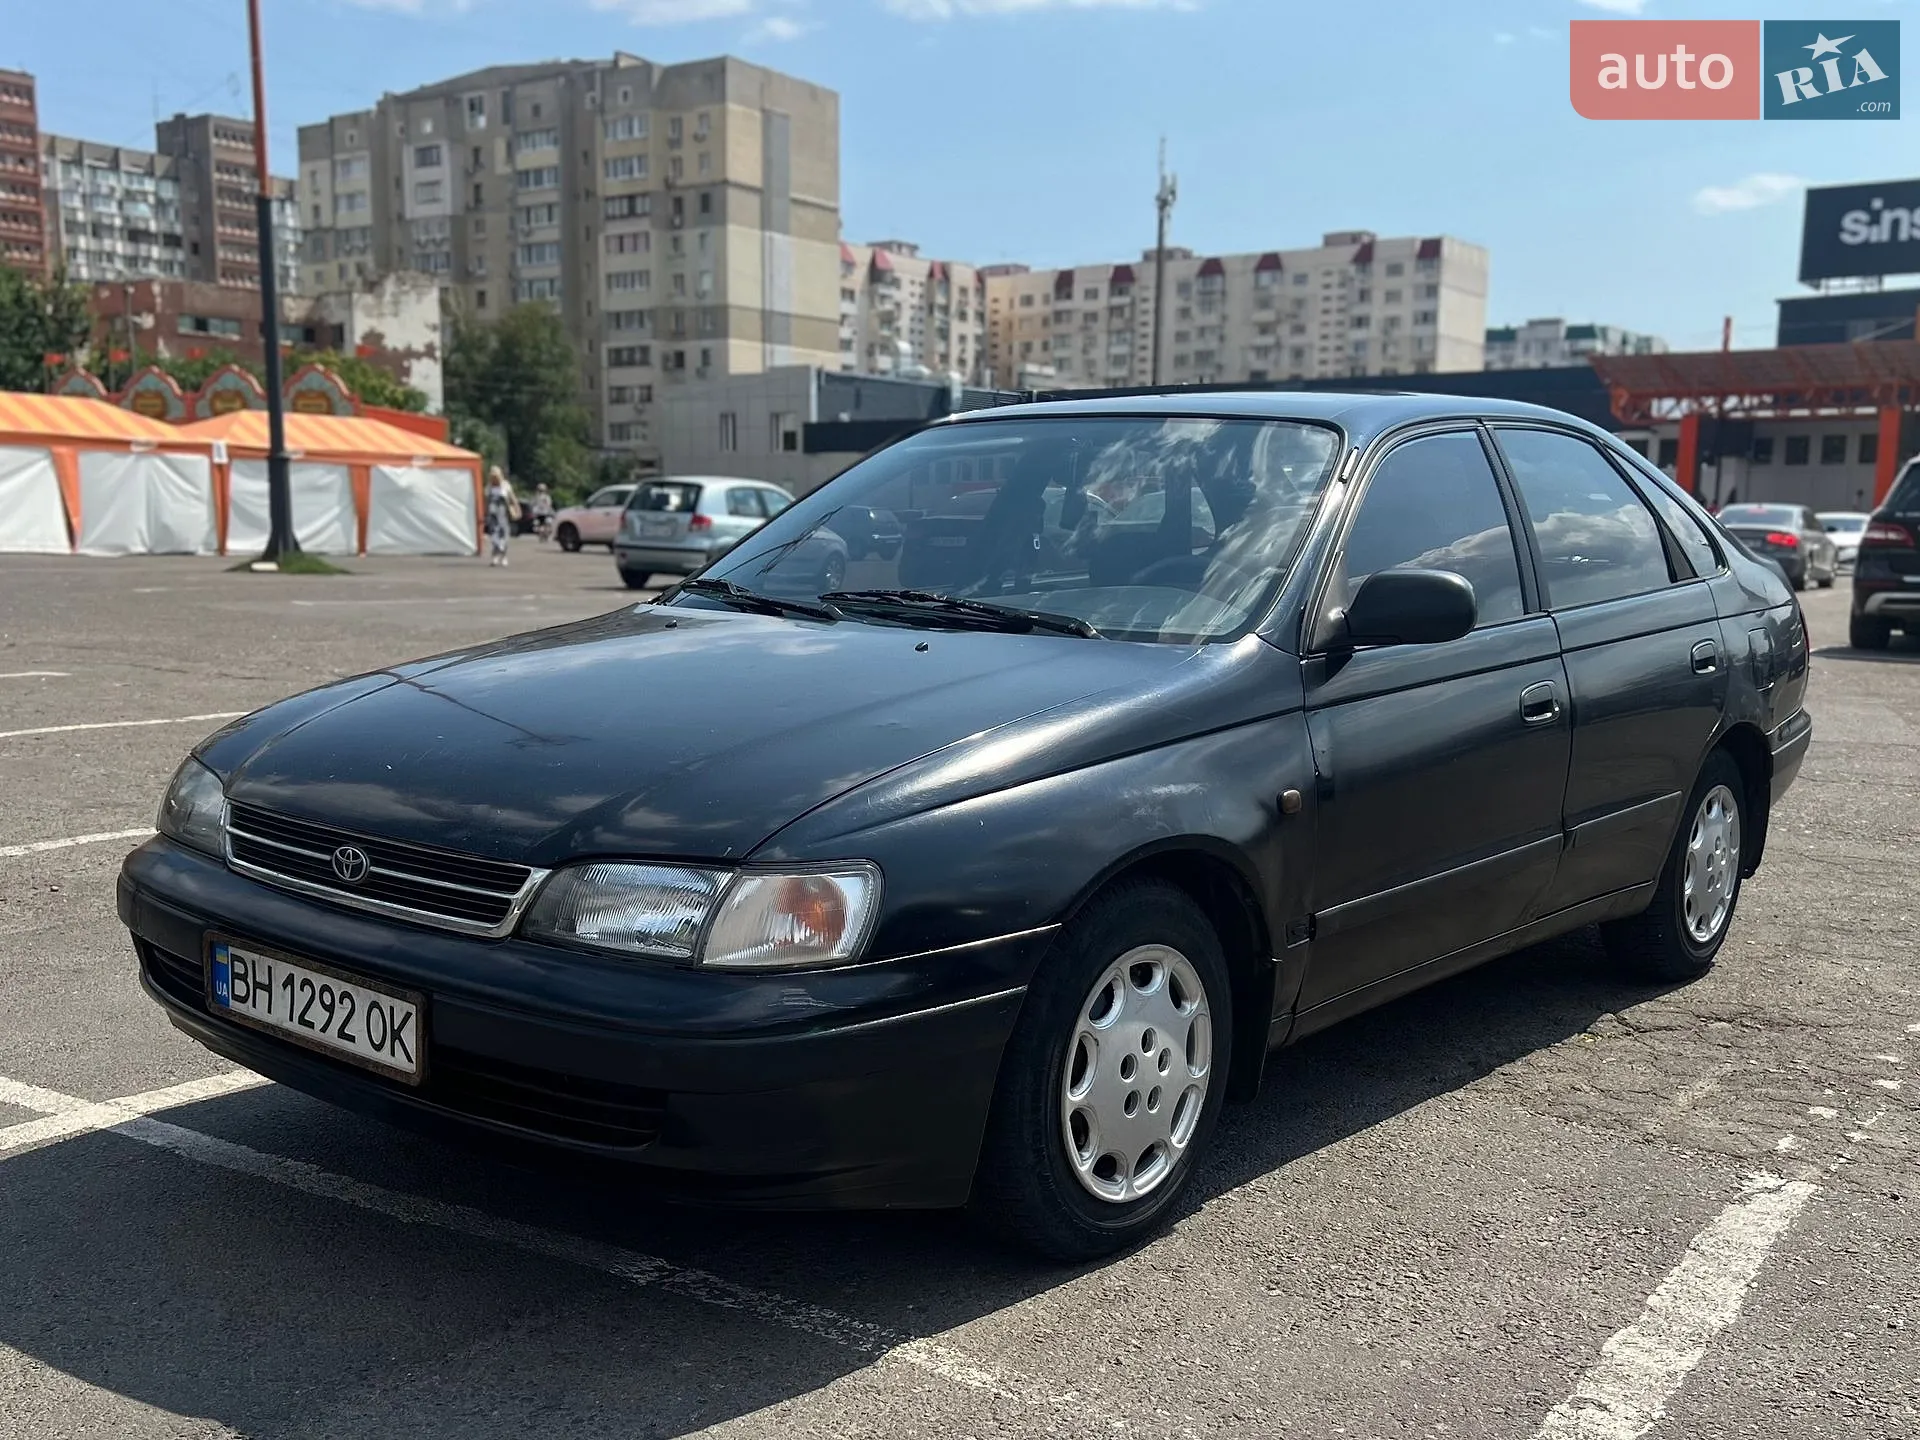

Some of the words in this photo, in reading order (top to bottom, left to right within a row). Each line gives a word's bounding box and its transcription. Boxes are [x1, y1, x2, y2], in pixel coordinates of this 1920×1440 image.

[1839, 197, 1920, 245] sin
[216, 980, 228, 998] UA
[230, 953, 273, 1014] BH
[282, 973, 356, 1043] 1292
[366, 1000, 414, 1064] OK
